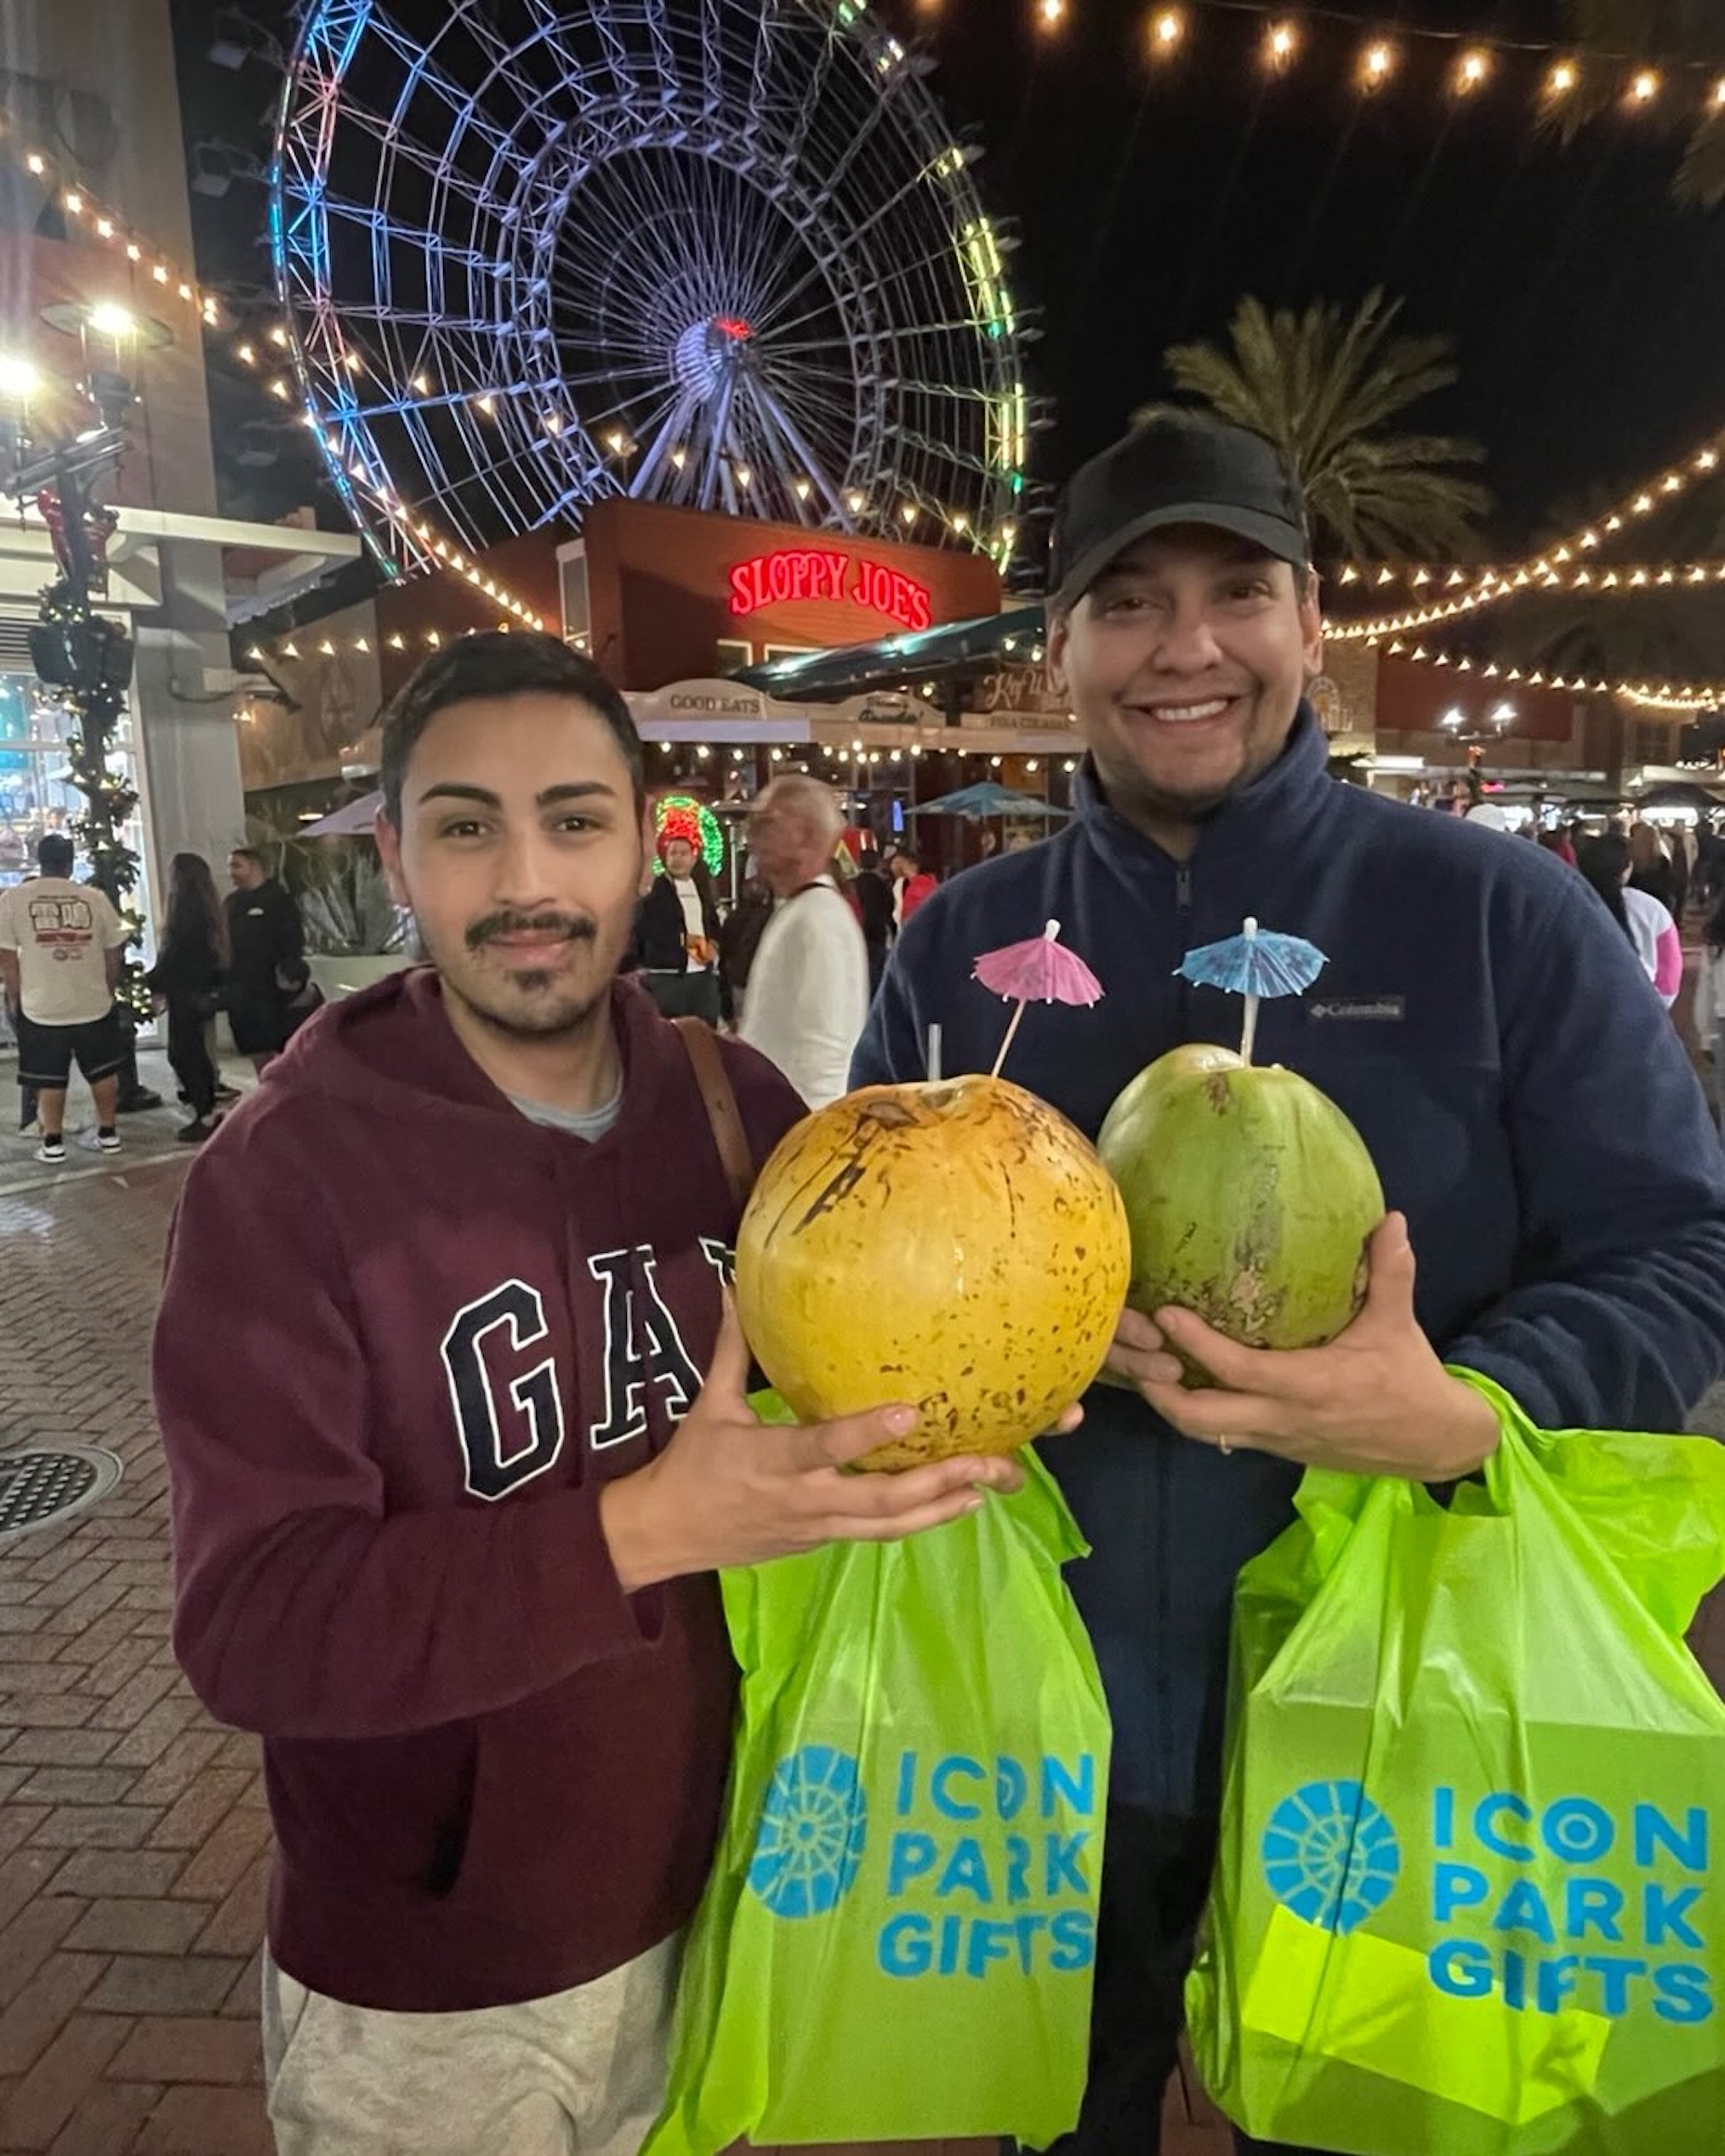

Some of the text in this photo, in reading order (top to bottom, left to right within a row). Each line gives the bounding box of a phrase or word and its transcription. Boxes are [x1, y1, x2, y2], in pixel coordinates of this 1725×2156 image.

[731, 552, 931, 631] SLOPPY JOE'S
[669, 694, 761, 714] GOOD EATS
[441, 1235, 737, 1502] GA
[1433, 1786, 1709, 1872] ICON
[877, 1909, 1096, 1978] GIFTS
[1432, 1862, 1705, 1949] PARK
[1428, 1939, 1715, 2024] GIFTS
